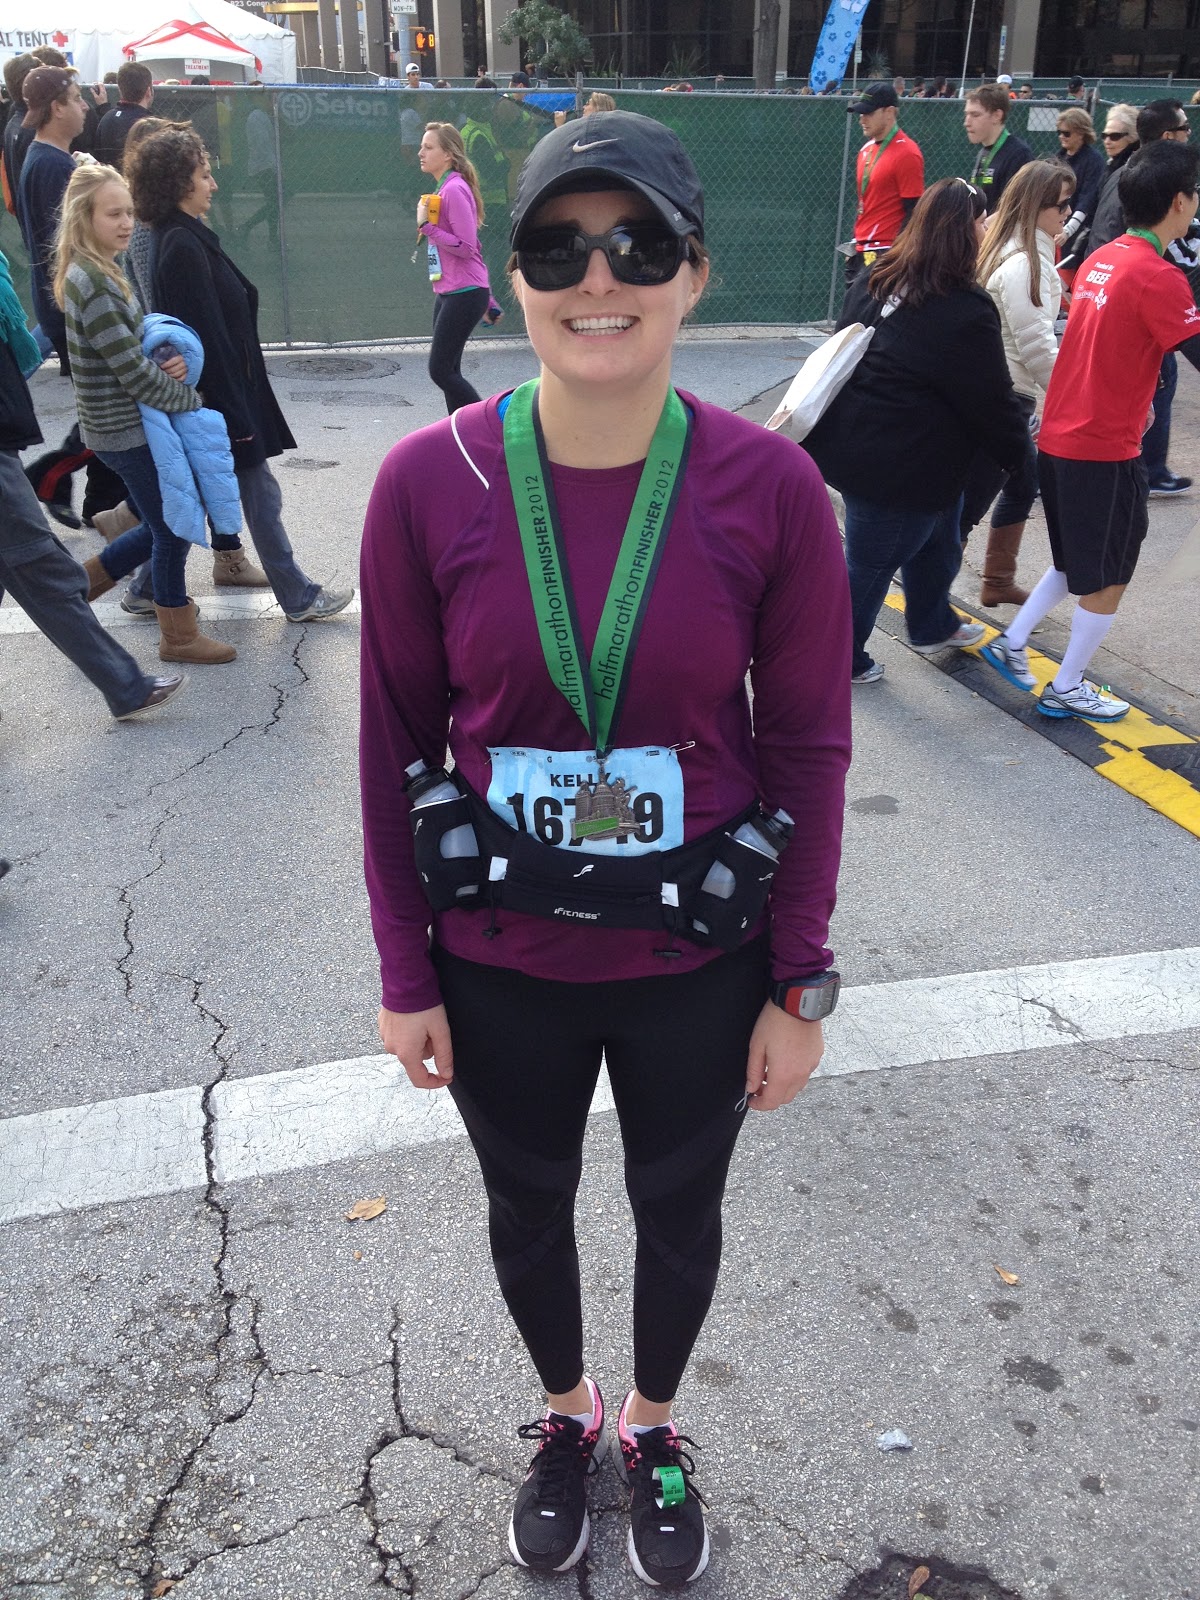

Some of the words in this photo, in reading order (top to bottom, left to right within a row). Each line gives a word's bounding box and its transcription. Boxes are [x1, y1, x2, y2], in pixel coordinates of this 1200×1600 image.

[16, 31, 49, 47] TENT
[315, 92, 389, 116] Seton
[1085, 270, 1112, 286] BEEF
[525, 475, 544, 514] 2012
[652, 459, 675, 500] 2012
[506, 792, 664, 847] 169
